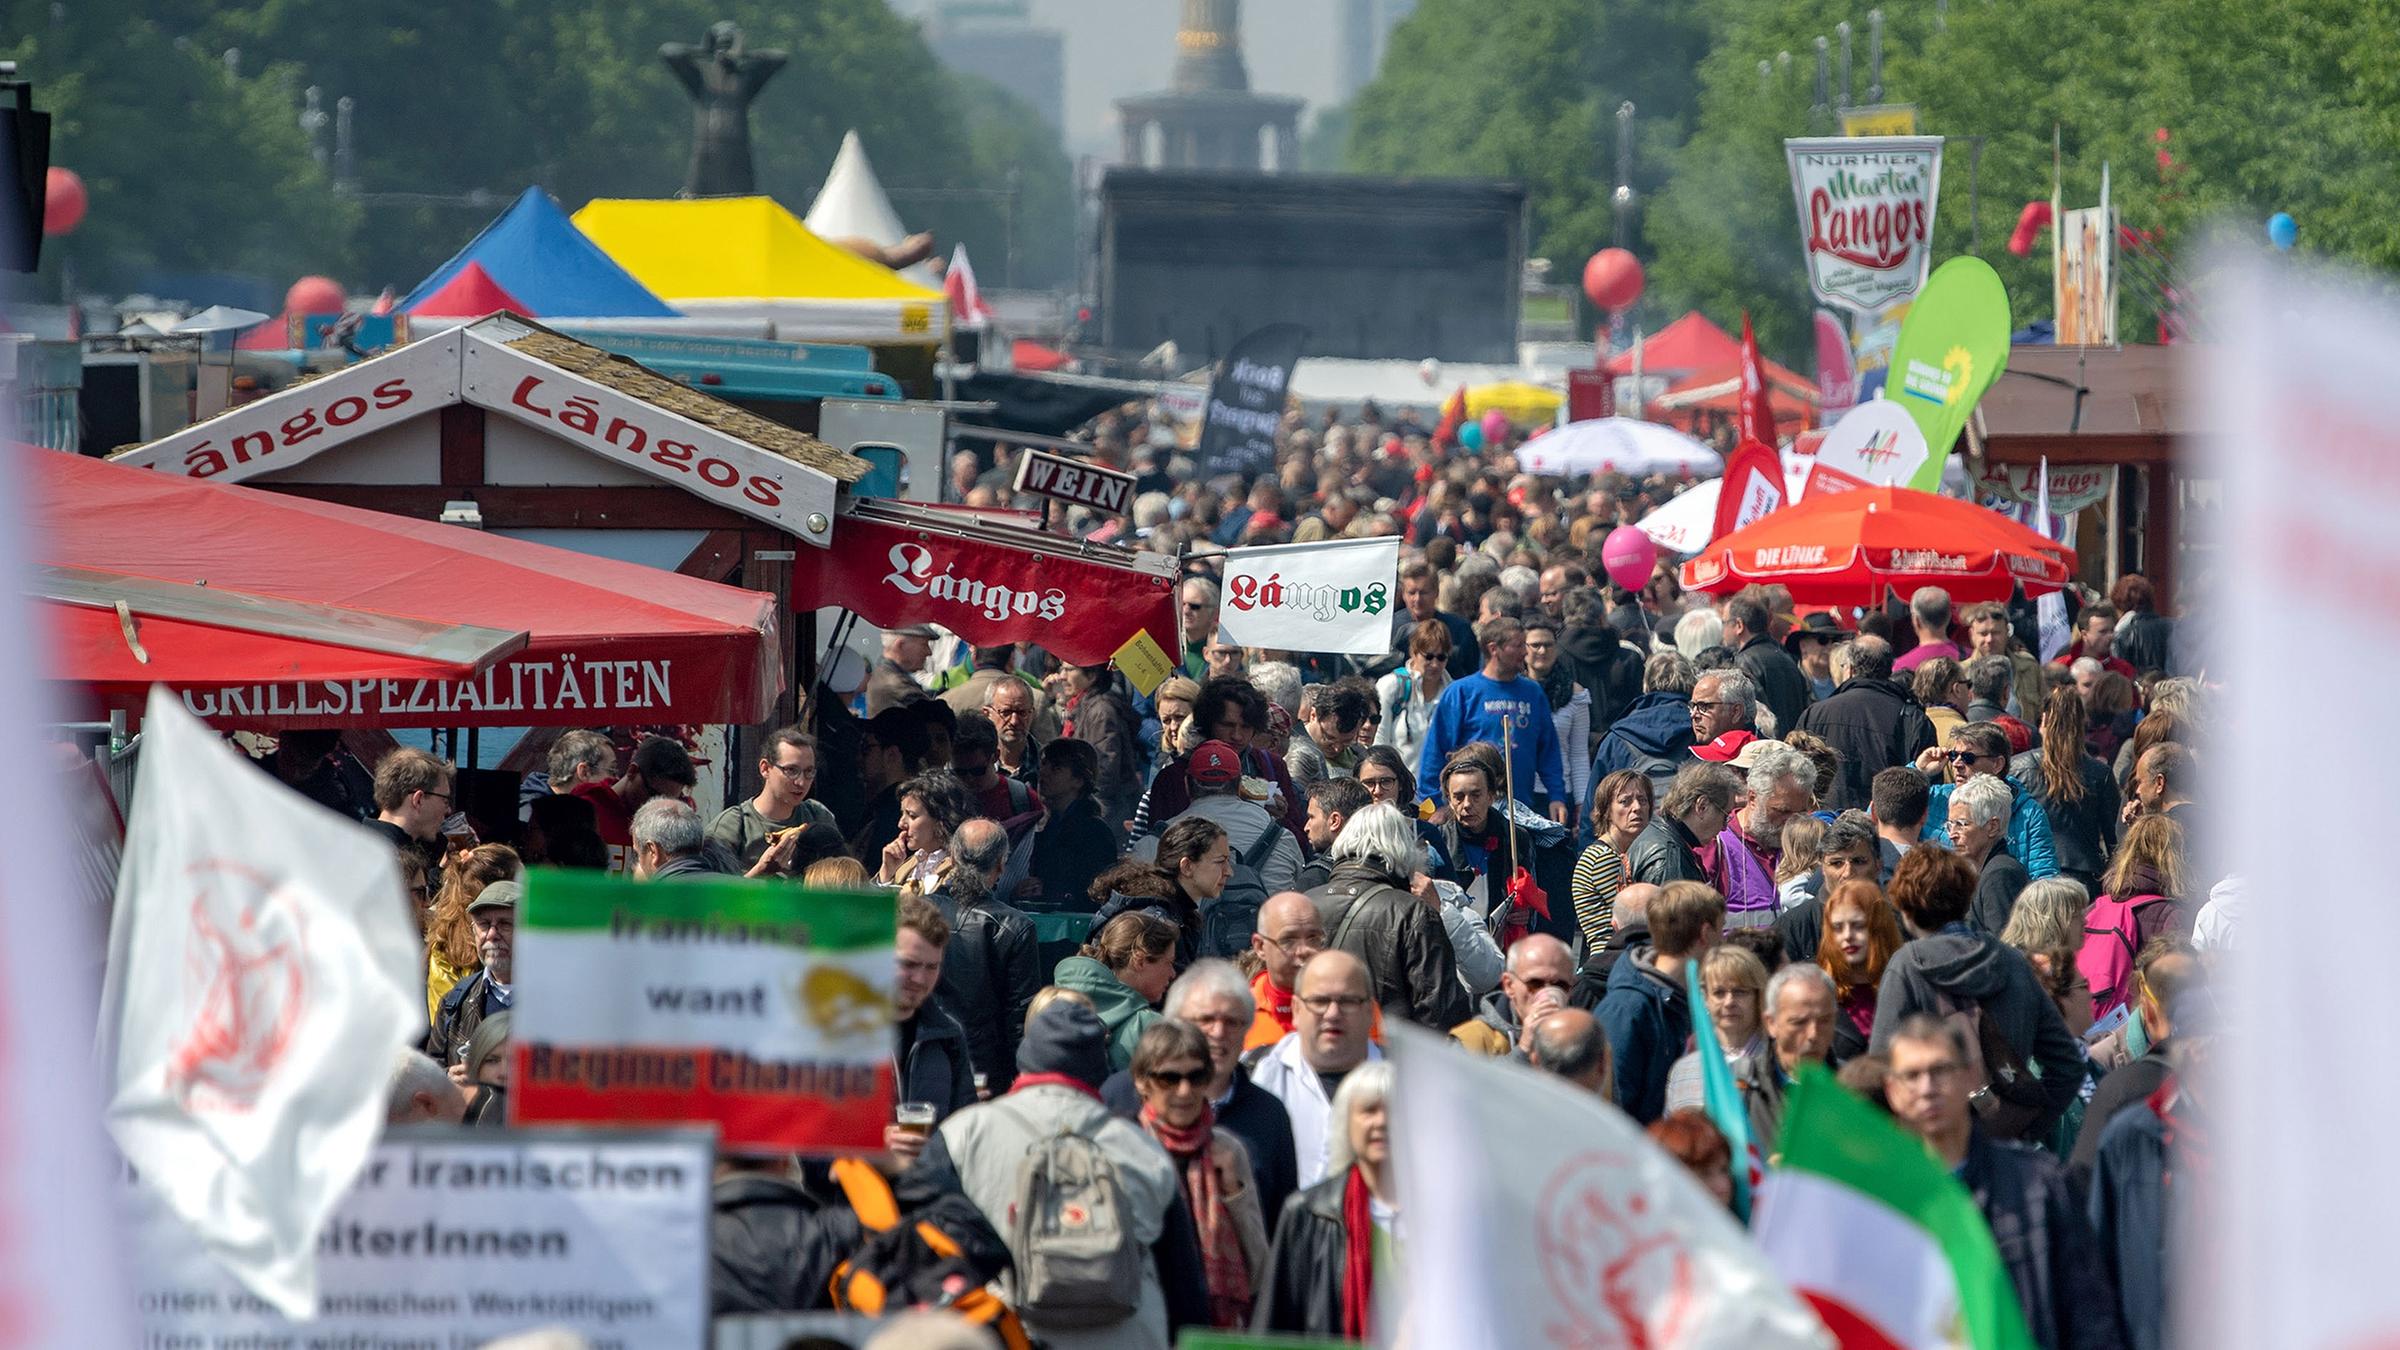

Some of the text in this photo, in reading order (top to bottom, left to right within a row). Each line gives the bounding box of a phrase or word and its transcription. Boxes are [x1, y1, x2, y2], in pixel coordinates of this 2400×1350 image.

[1809, 187, 1927, 263] Langos
[142, 379, 413, 478] ángos
[512, 375, 783, 506] Lángos
[1030, 458, 1127, 510] WEIN
[882, 543, 1066, 621] Lángos
[1755, 547, 1781, 568] DIE
[1228, 573, 1387, 622] Lángos
[646, 985, 766, 1021] want
[530, 1044, 878, 1099] Regime Change
[410, 1150, 686, 1190] iranischen
[319, 1292, 456, 1316] anischen
